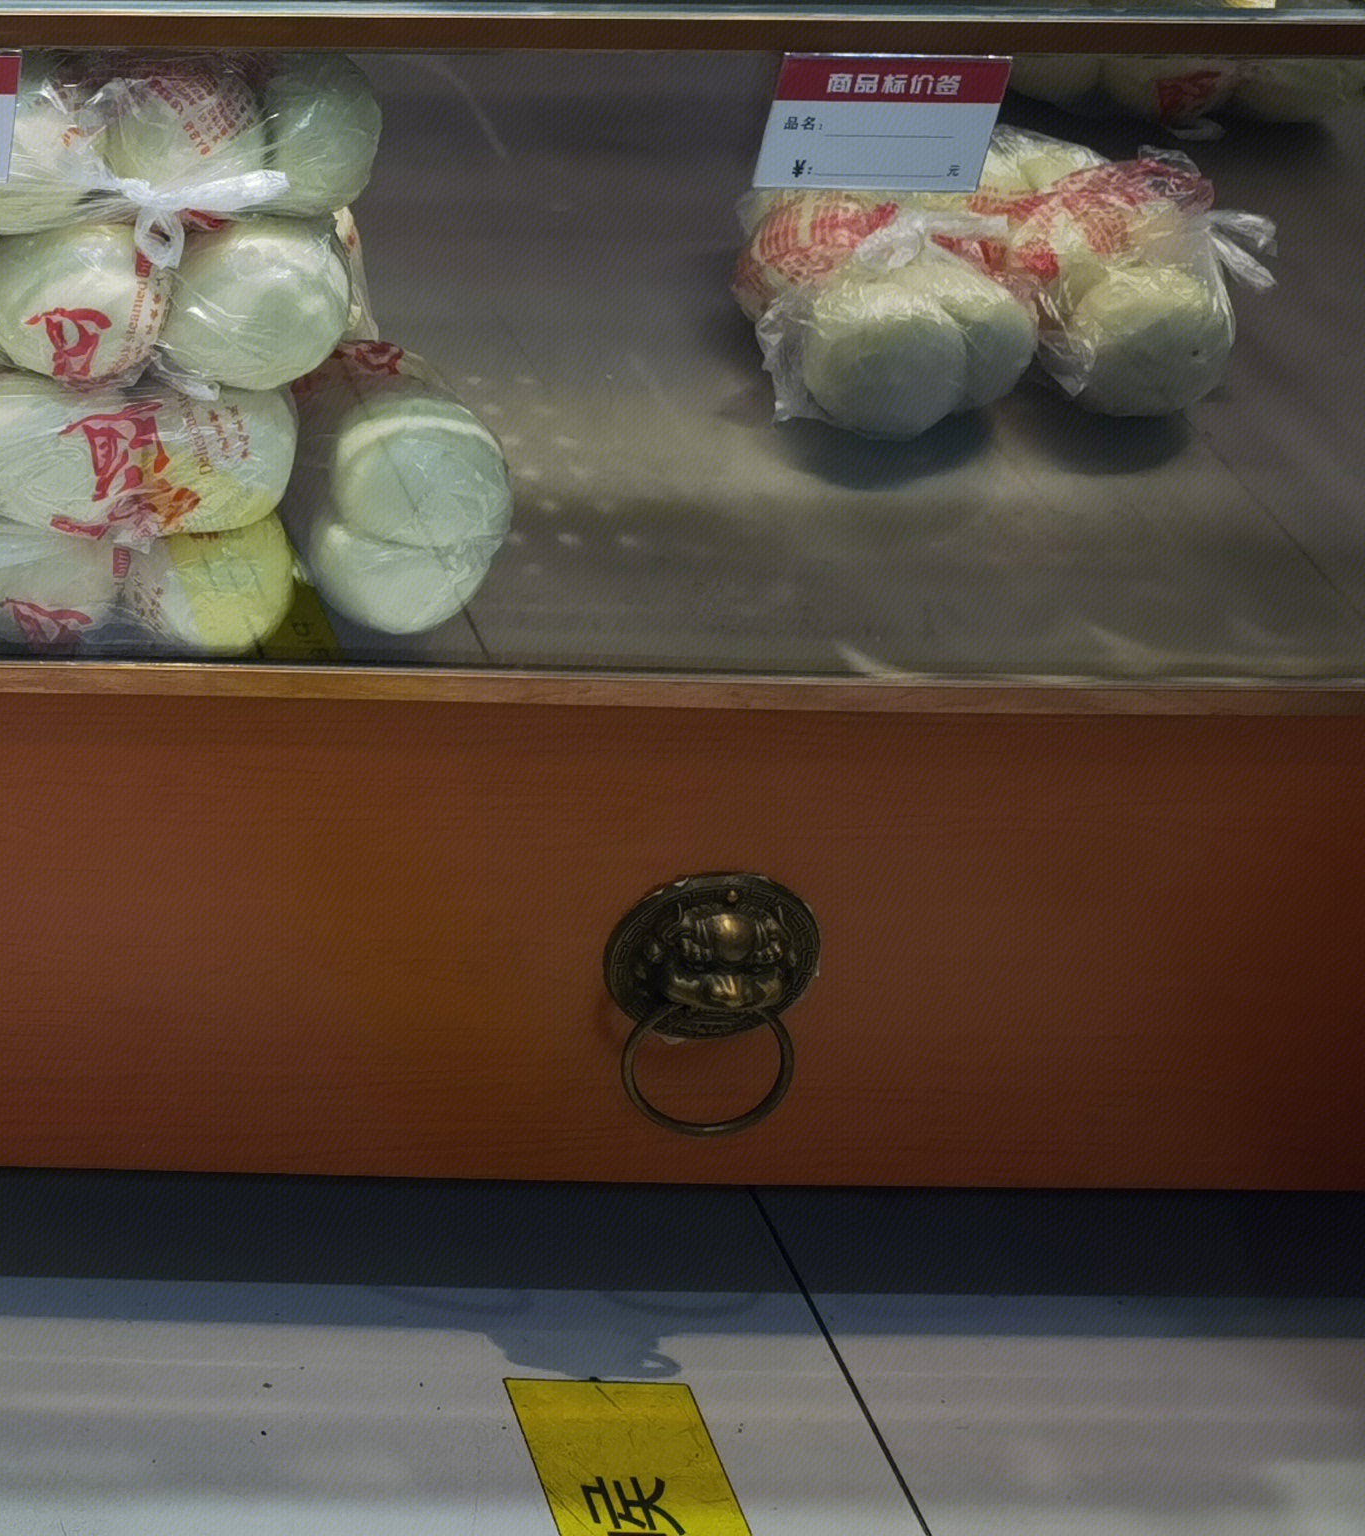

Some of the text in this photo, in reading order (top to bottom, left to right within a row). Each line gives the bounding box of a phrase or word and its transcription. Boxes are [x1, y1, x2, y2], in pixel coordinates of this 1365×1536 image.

[826, 73, 962, 96] 商品标价签
[946, 163, 961, 177] 元
